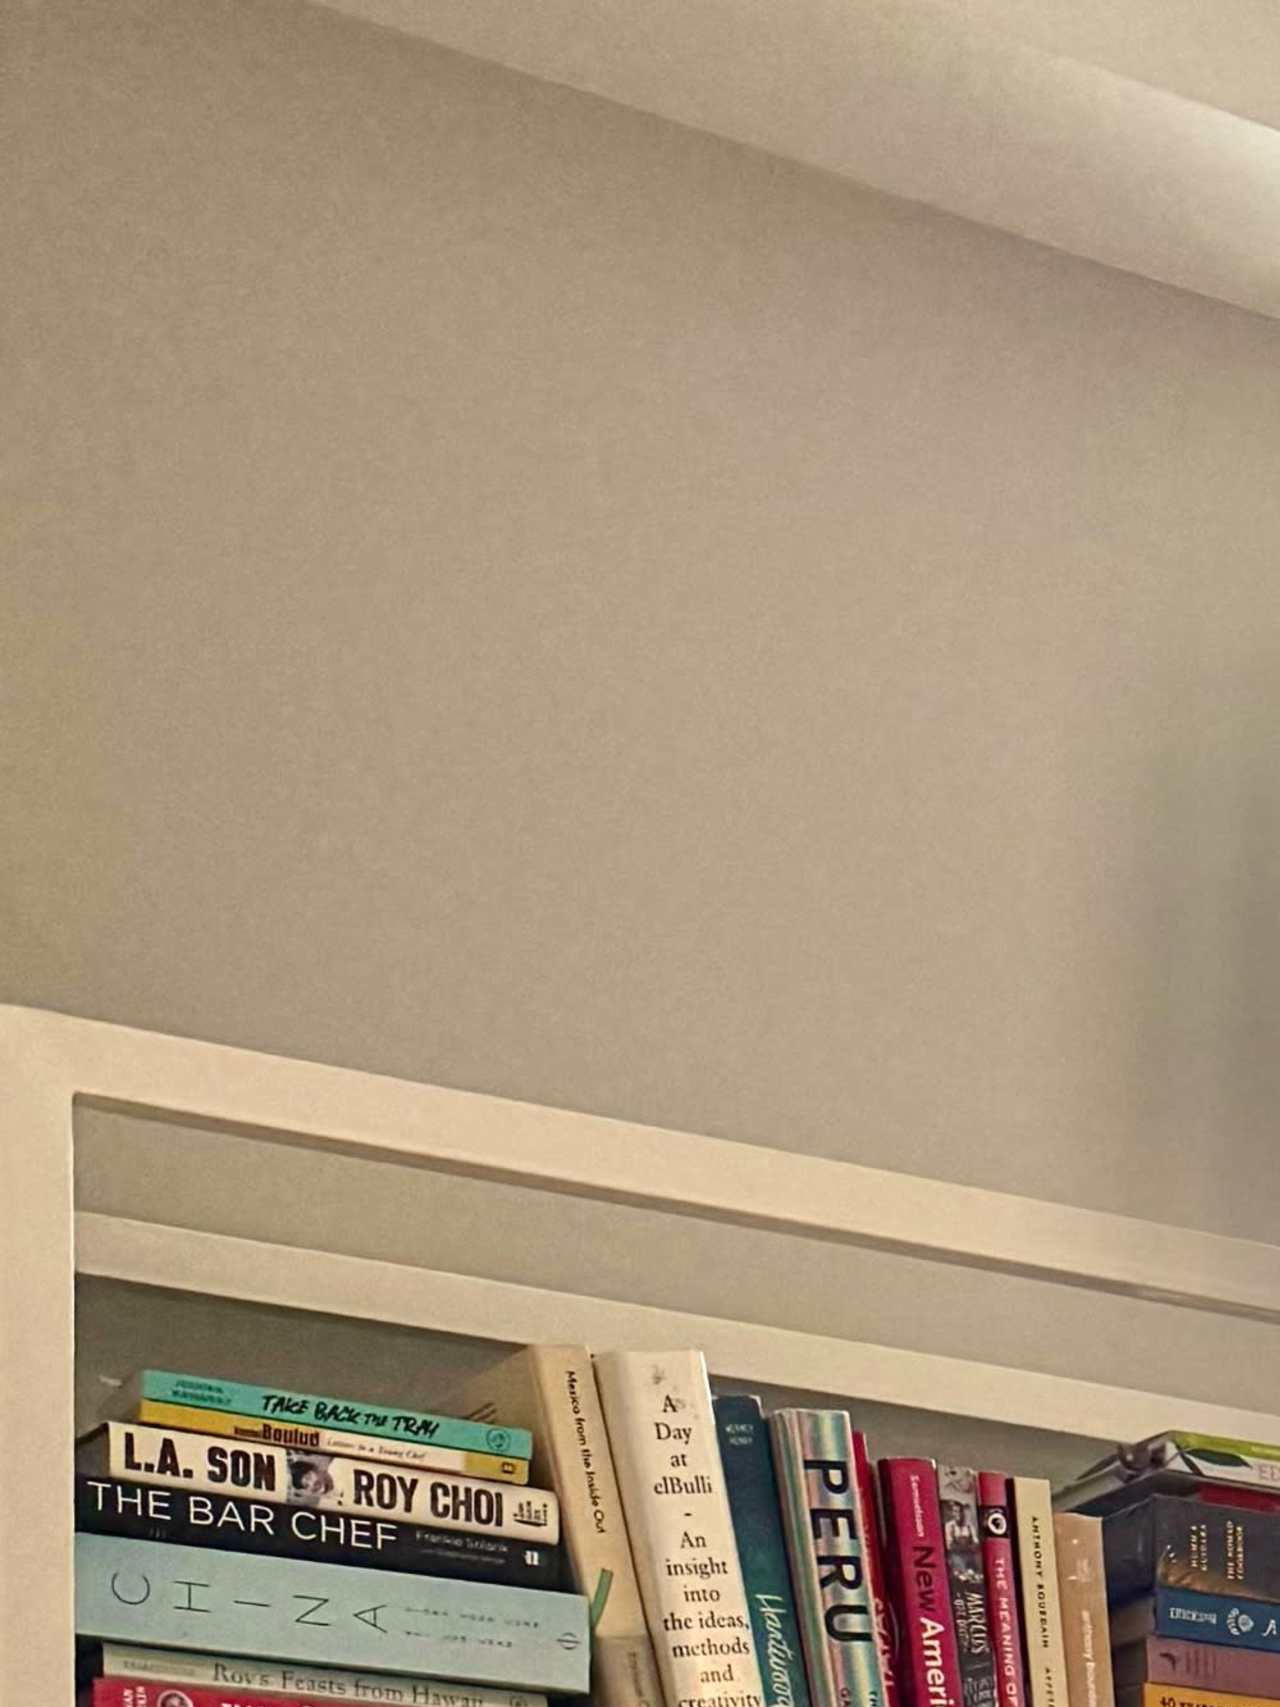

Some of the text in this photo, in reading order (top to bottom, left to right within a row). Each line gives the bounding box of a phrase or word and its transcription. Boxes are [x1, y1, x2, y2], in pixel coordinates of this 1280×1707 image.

[662, 1394, 678, 1413] A
[654, 1422, 692, 1445] Day
[125, 1432, 275, 1491] L.A. SON
[670, 1452, 687, 1468] at
[653, 1475, 712, 1495] elBulli
[353, 1469, 503, 1527] ROY CHOI
[87, 1481, 398, 1550] THE BAR CHEF
[680, 1532, 707, 1549] An
[804, 1459, 872, 1643] PERU
[665, 1557, 728, 1580] insight
[912, 1545, 936, 1612] New
[684, 1585, 720, 1603] into
[663, 1611, 750, 1631] the ideas,
[672, 1637, 750, 1658] methods
[700, 1665, 734, 1682] and
